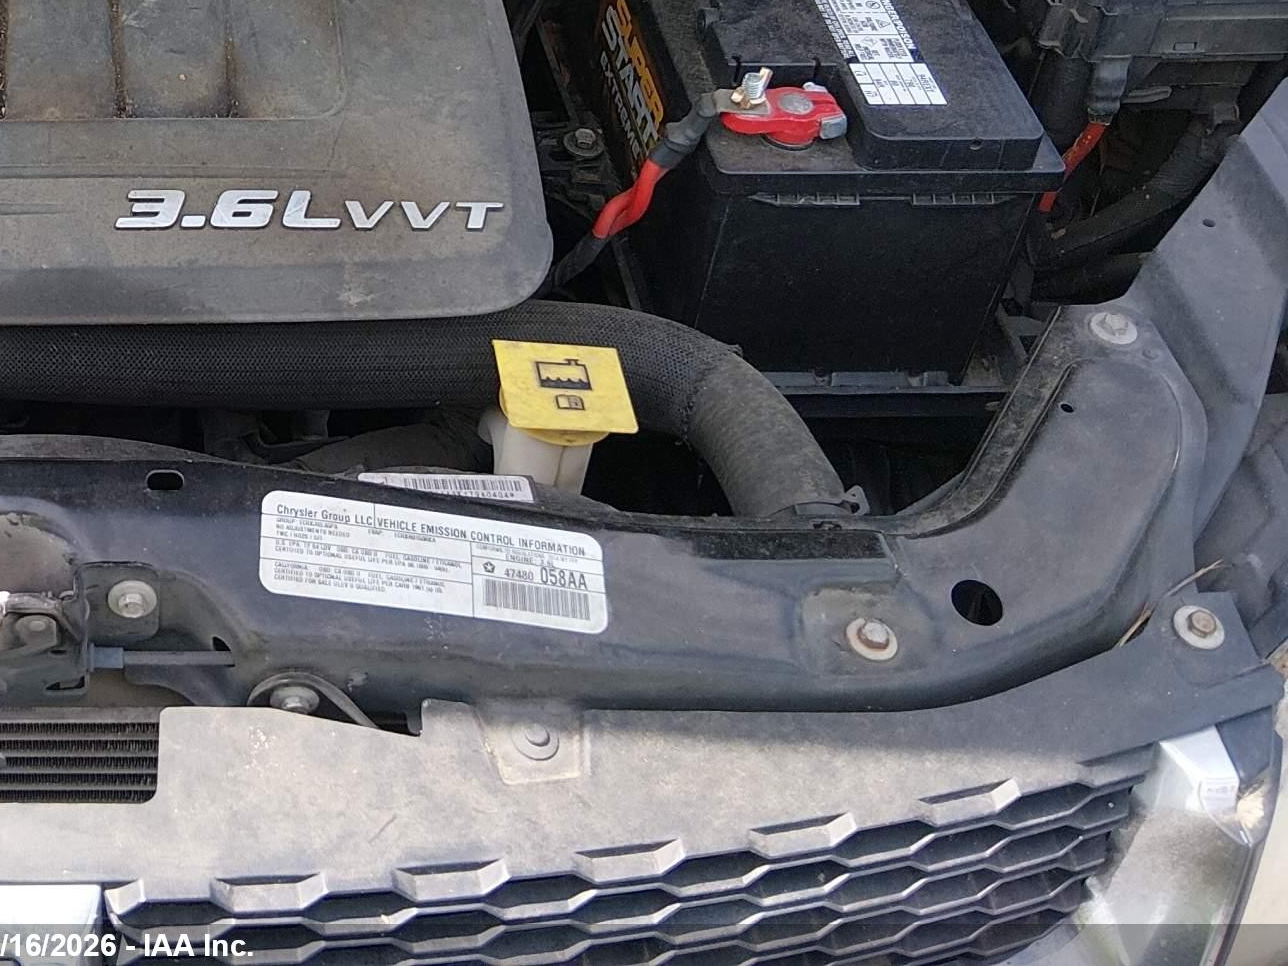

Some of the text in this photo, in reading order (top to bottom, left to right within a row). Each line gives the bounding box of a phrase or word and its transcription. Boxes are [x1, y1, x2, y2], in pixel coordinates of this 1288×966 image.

[601, 4, 659, 145] START
[114, 189, 505, 230] 3.6L VVT
[277, 504, 318, 519] Chrysler
[321, 509, 351, 524] Group
[355, 515, 373, 526] LLC
[377, 517, 416, 532] VEHICLE
[421, 521, 467, 539] EMISSION
[470, 530, 515, 547] CONTROL
[518, 537, 586, 557] INFORMATION
[504, 566, 588, 590] 47480 058AA
